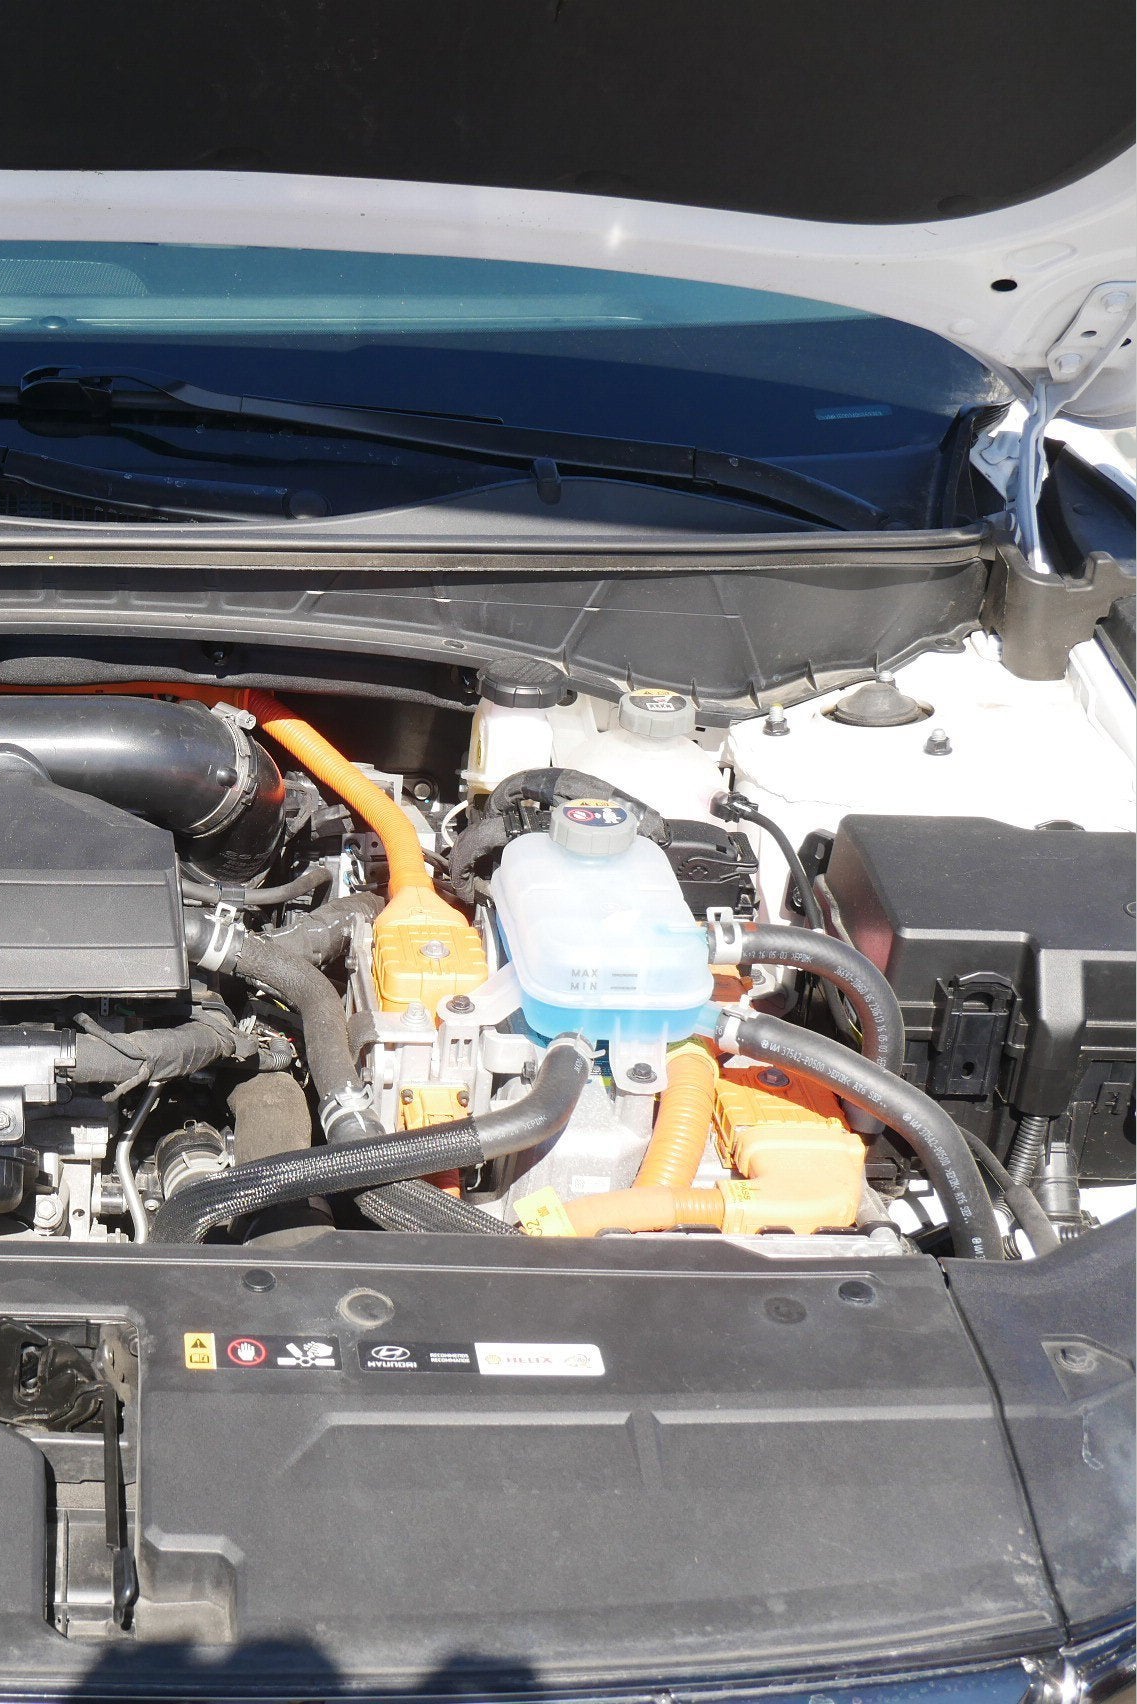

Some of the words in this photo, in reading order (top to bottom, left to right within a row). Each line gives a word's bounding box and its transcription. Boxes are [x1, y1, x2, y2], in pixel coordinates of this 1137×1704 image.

[571, 968, 599, 978] MAX
[570, 982, 598, 991] MIN
[367, 1360, 418, 1369] HYUNDAI
